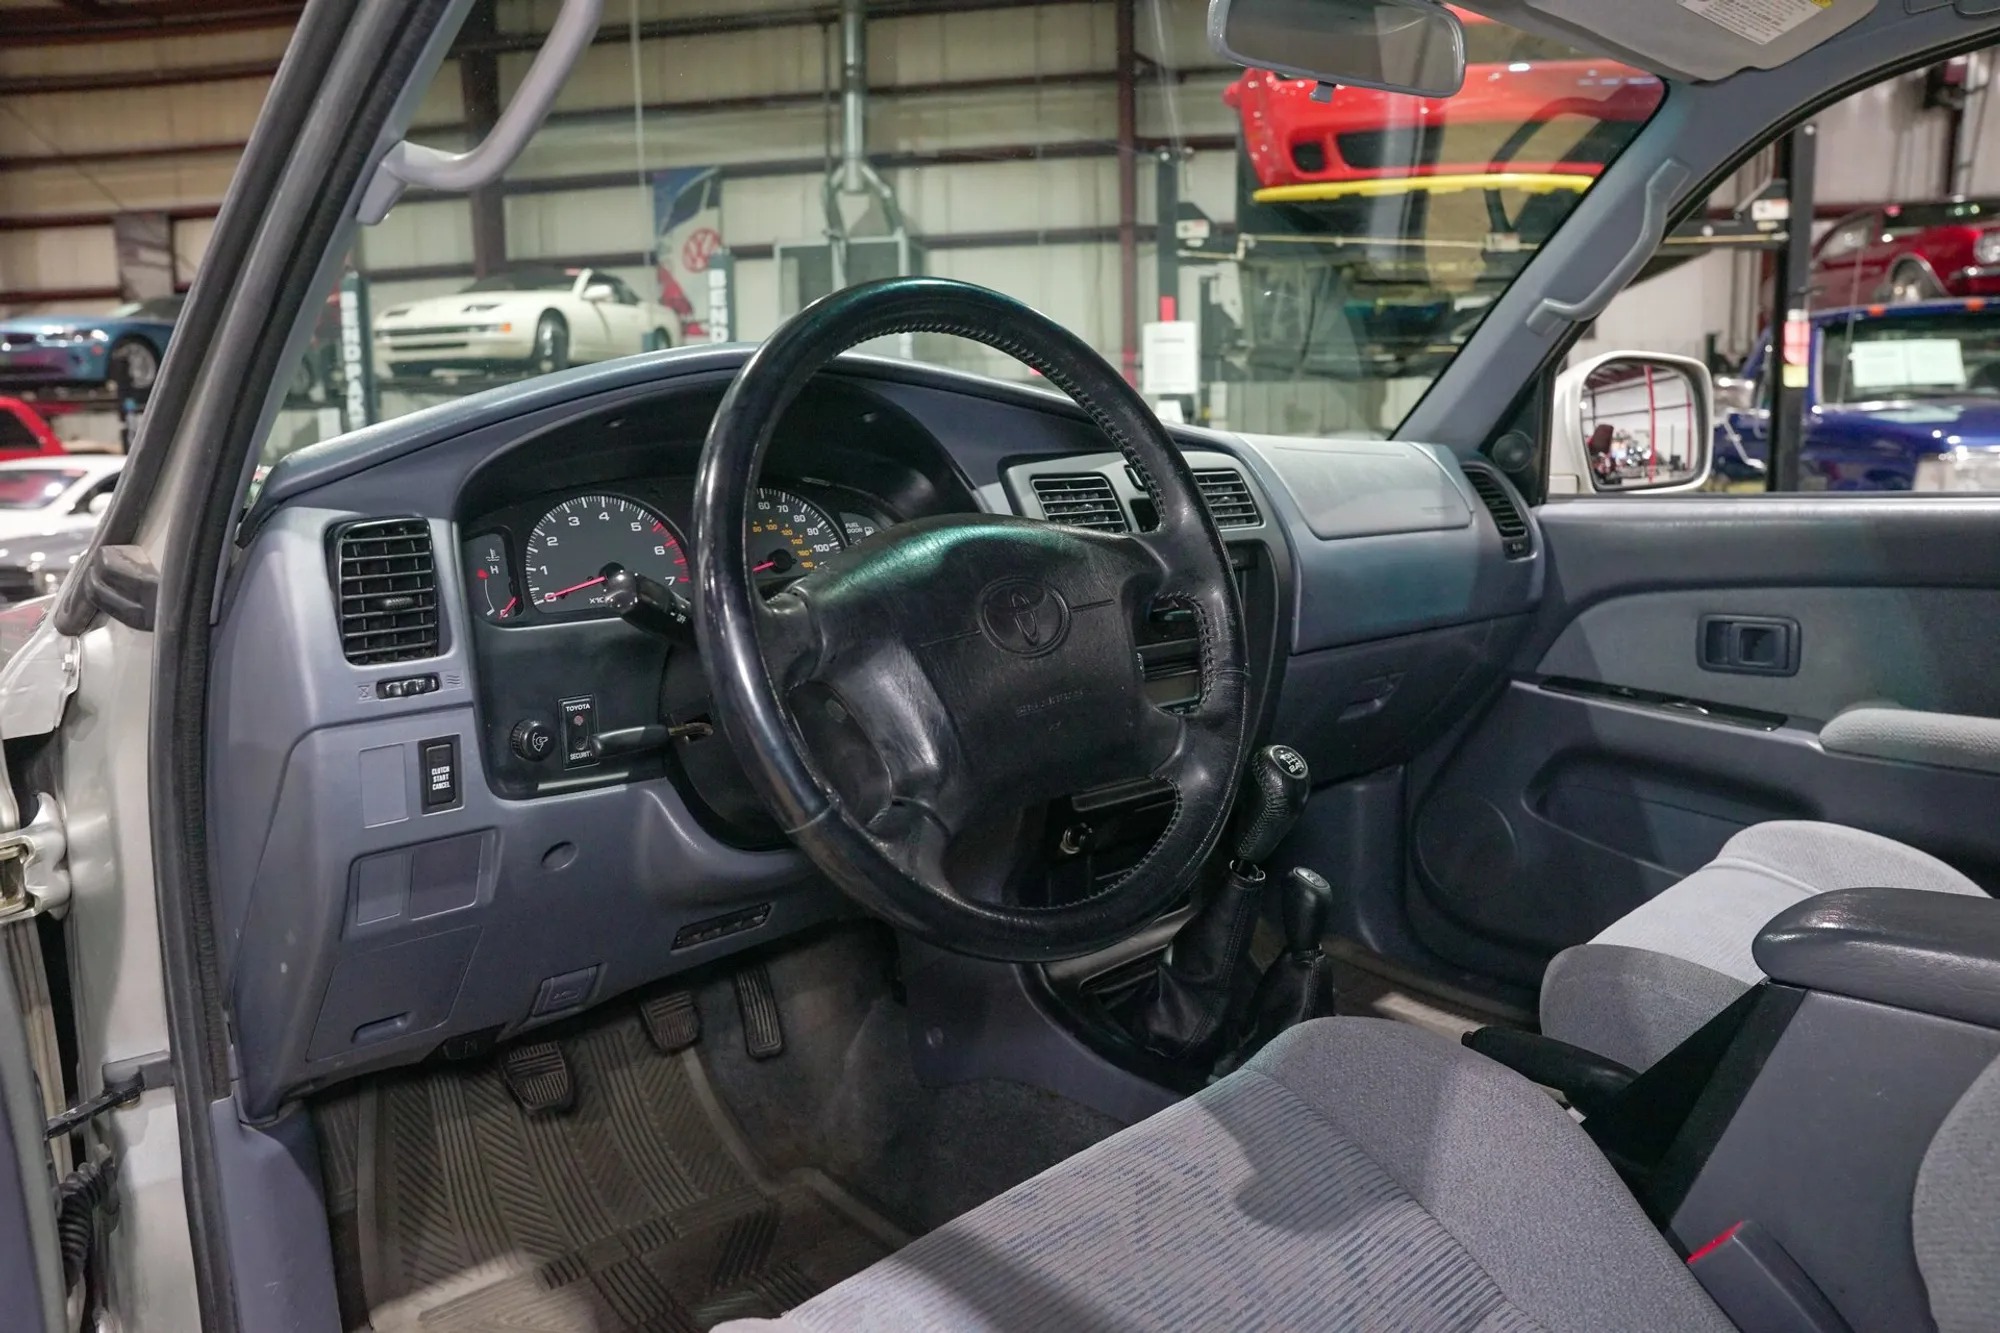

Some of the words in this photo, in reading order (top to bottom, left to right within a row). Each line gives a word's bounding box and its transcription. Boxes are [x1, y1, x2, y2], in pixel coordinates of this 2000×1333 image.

[568, 516, 580, 526] 3
[599, 512, 610, 521] 4
[631, 522, 642, 532] 5
[807, 528, 819, 536] 90
[546, 536, 559, 546] 2
[654, 545, 665, 555] 6
[490, 565, 499, 574] H
[540, 565, 548, 575] 1
[665, 576, 675, 586] 7
[565, 703, 590, 712] TOYOTA
[431, 765, 450, 775] CLUTCH
[433, 773, 449, 783] START
[432, 781, 451, 791] CANCEL
